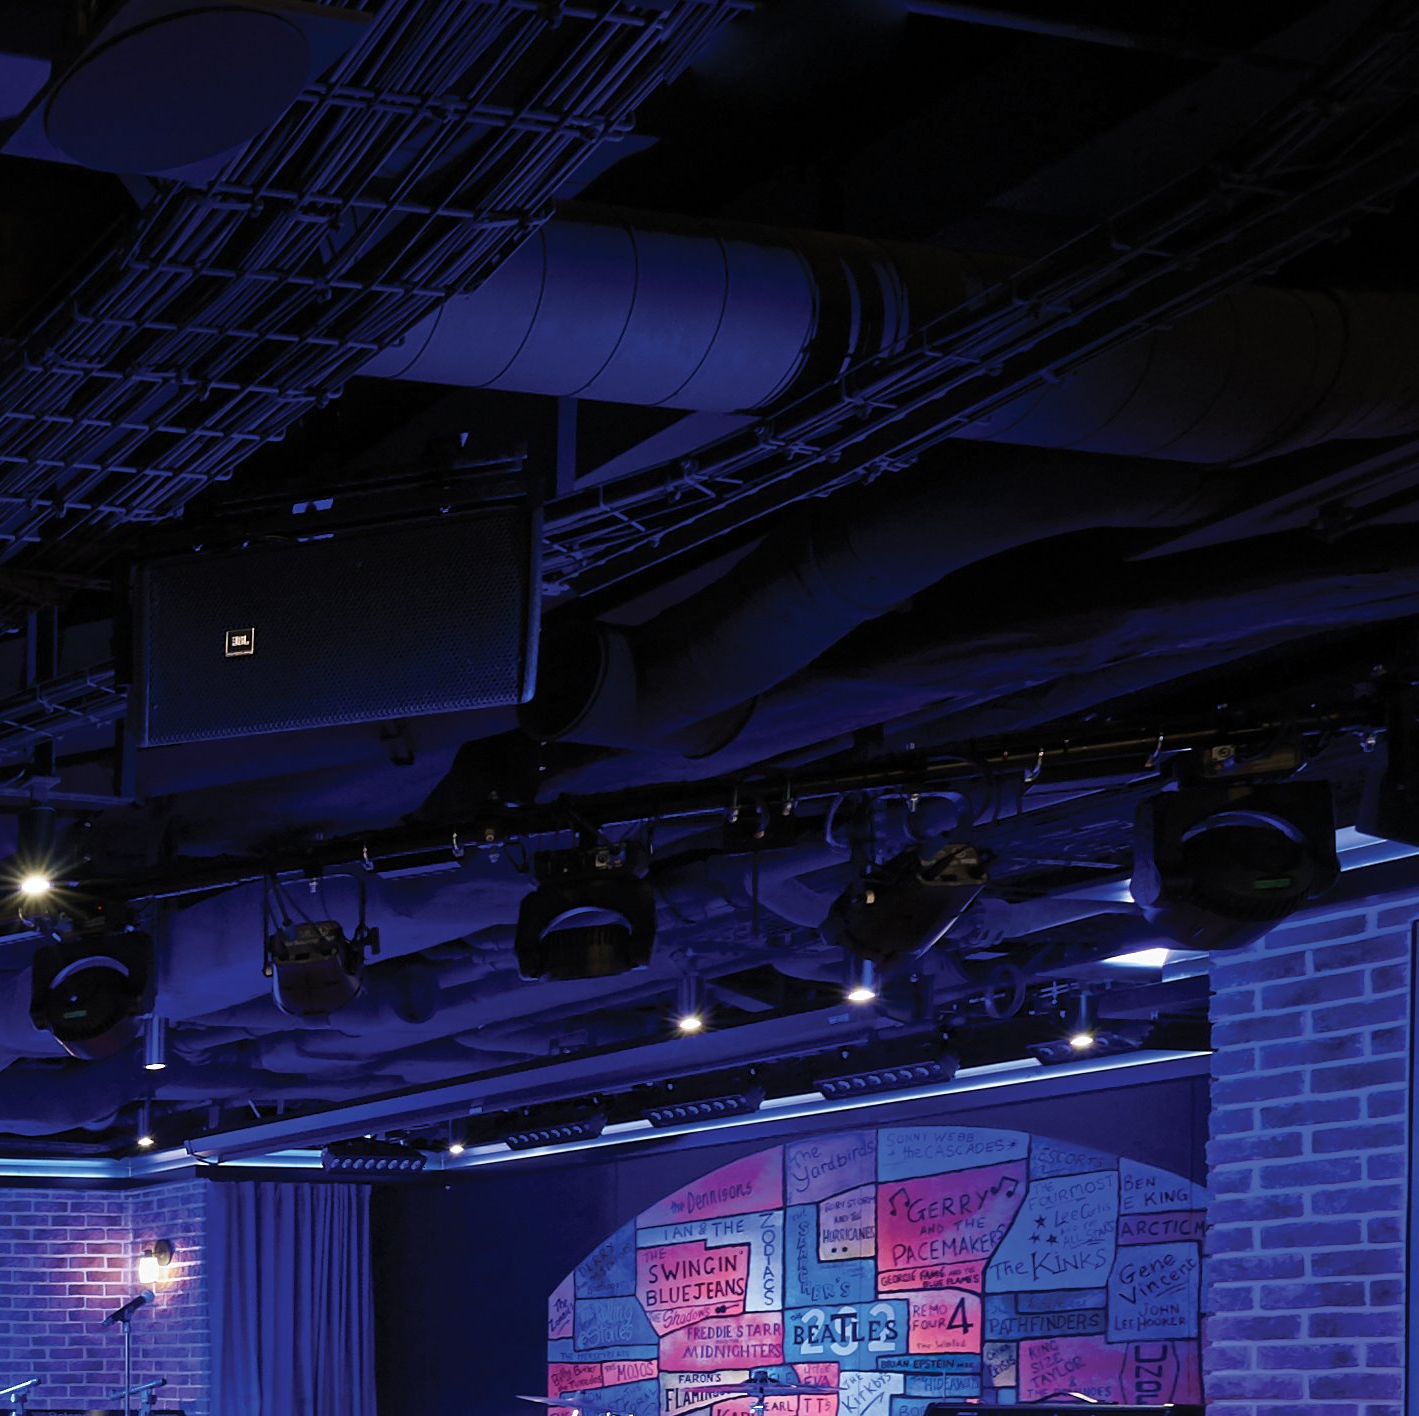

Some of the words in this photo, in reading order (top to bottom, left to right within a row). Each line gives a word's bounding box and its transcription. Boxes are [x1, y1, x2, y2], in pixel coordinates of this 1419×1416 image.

[231, 634, 250, 647] JBL
[886, 1133, 927, 1147] SONNY
[933, 1131, 975, 1144] WEBB
[924, 1138, 1005, 1158] CASCADES
[1028, 1174, 1113, 1211] FOURMOST
[1123, 1175, 1156, 1192] BEN
[907, 1189, 989, 1224] GERRY
[1123, 1195, 1134, 1210] E
[1144, 1188, 1189, 1207] KING
[663, 1224, 693, 1241] IAN
[711, 1219, 745, 1238] THE
[919, 1222, 945, 1236] AND
[953, 1216, 987, 1231] THE
[1121, 1219, 1193, 1238] ARCTIC
[891, 1224, 1006, 1267] PACEMAKERS
[758, 1212, 777, 1306] ZODIACS
[989, 1261, 1029, 1281] The
[1119, 1254, 1176, 1285] Gene
[912, 1303, 948, 1318] REMO
[946, 1297, 974, 1335] 4
[1138, 1303, 1180, 1317] JOHN
[686, 1324, 733, 1341] FREDDIE
[793, 1312, 899, 1345] BEATLES
[912, 1317, 946, 1332] FOUR
[989, 1312, 1100, 1336] PATHFINDERS
[682, 1343, 782, 1359] MIDNIGHTERS
